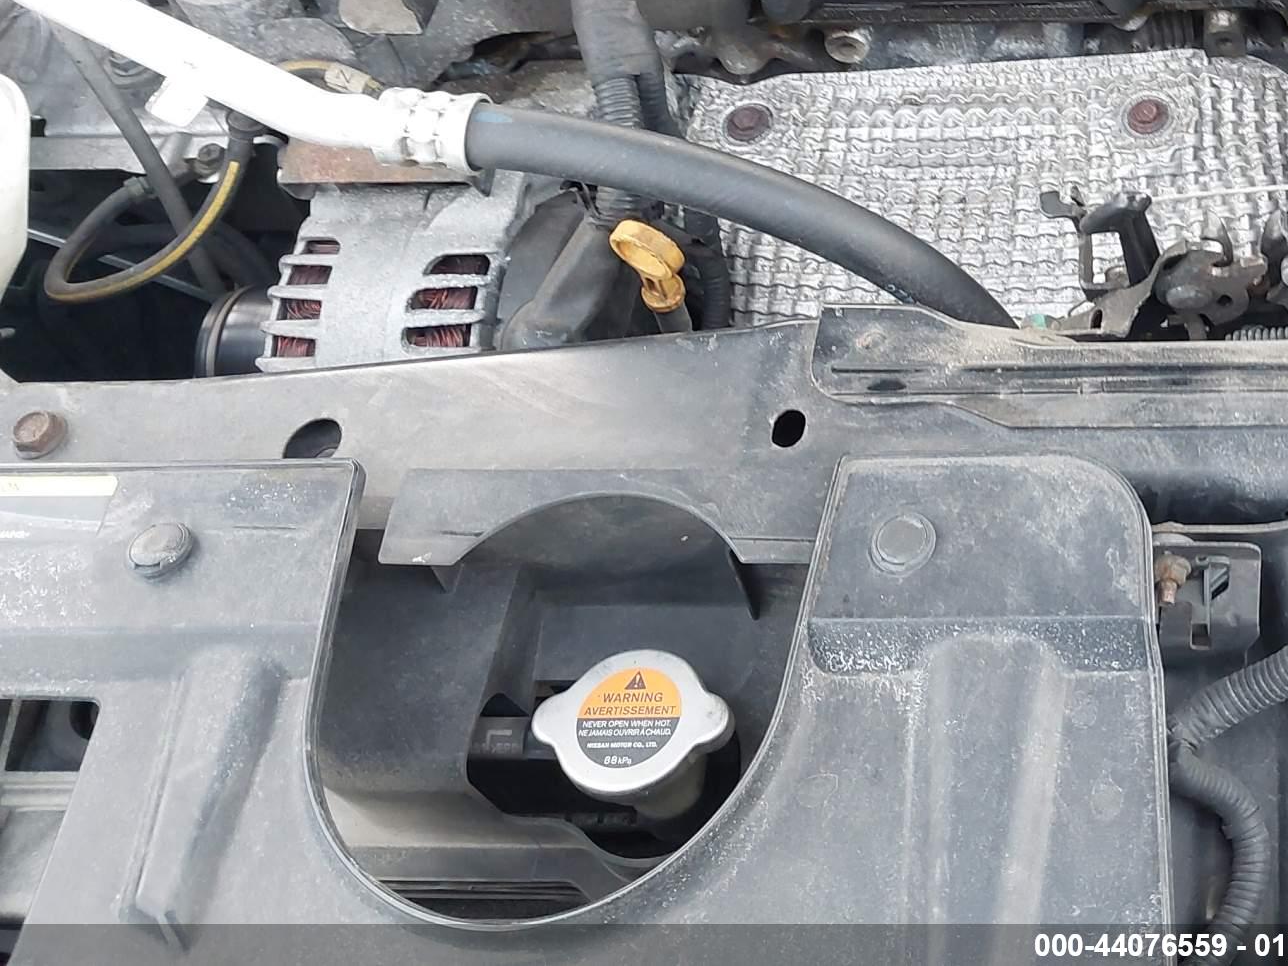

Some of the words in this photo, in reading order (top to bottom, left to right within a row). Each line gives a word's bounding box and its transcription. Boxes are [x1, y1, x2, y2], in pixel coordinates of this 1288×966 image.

[603, 692, 664, 703] WARNING
[584, 705, 677, 716] AVERTISSEMENT
[582, 720, 607, 728] NEVER
[608, 720, 629, 728] OPEN
[630, 720, 654, 728] WHEN
[578, 729, 588, 737] NE
[588, 729, 613, 737] JAMAIS
